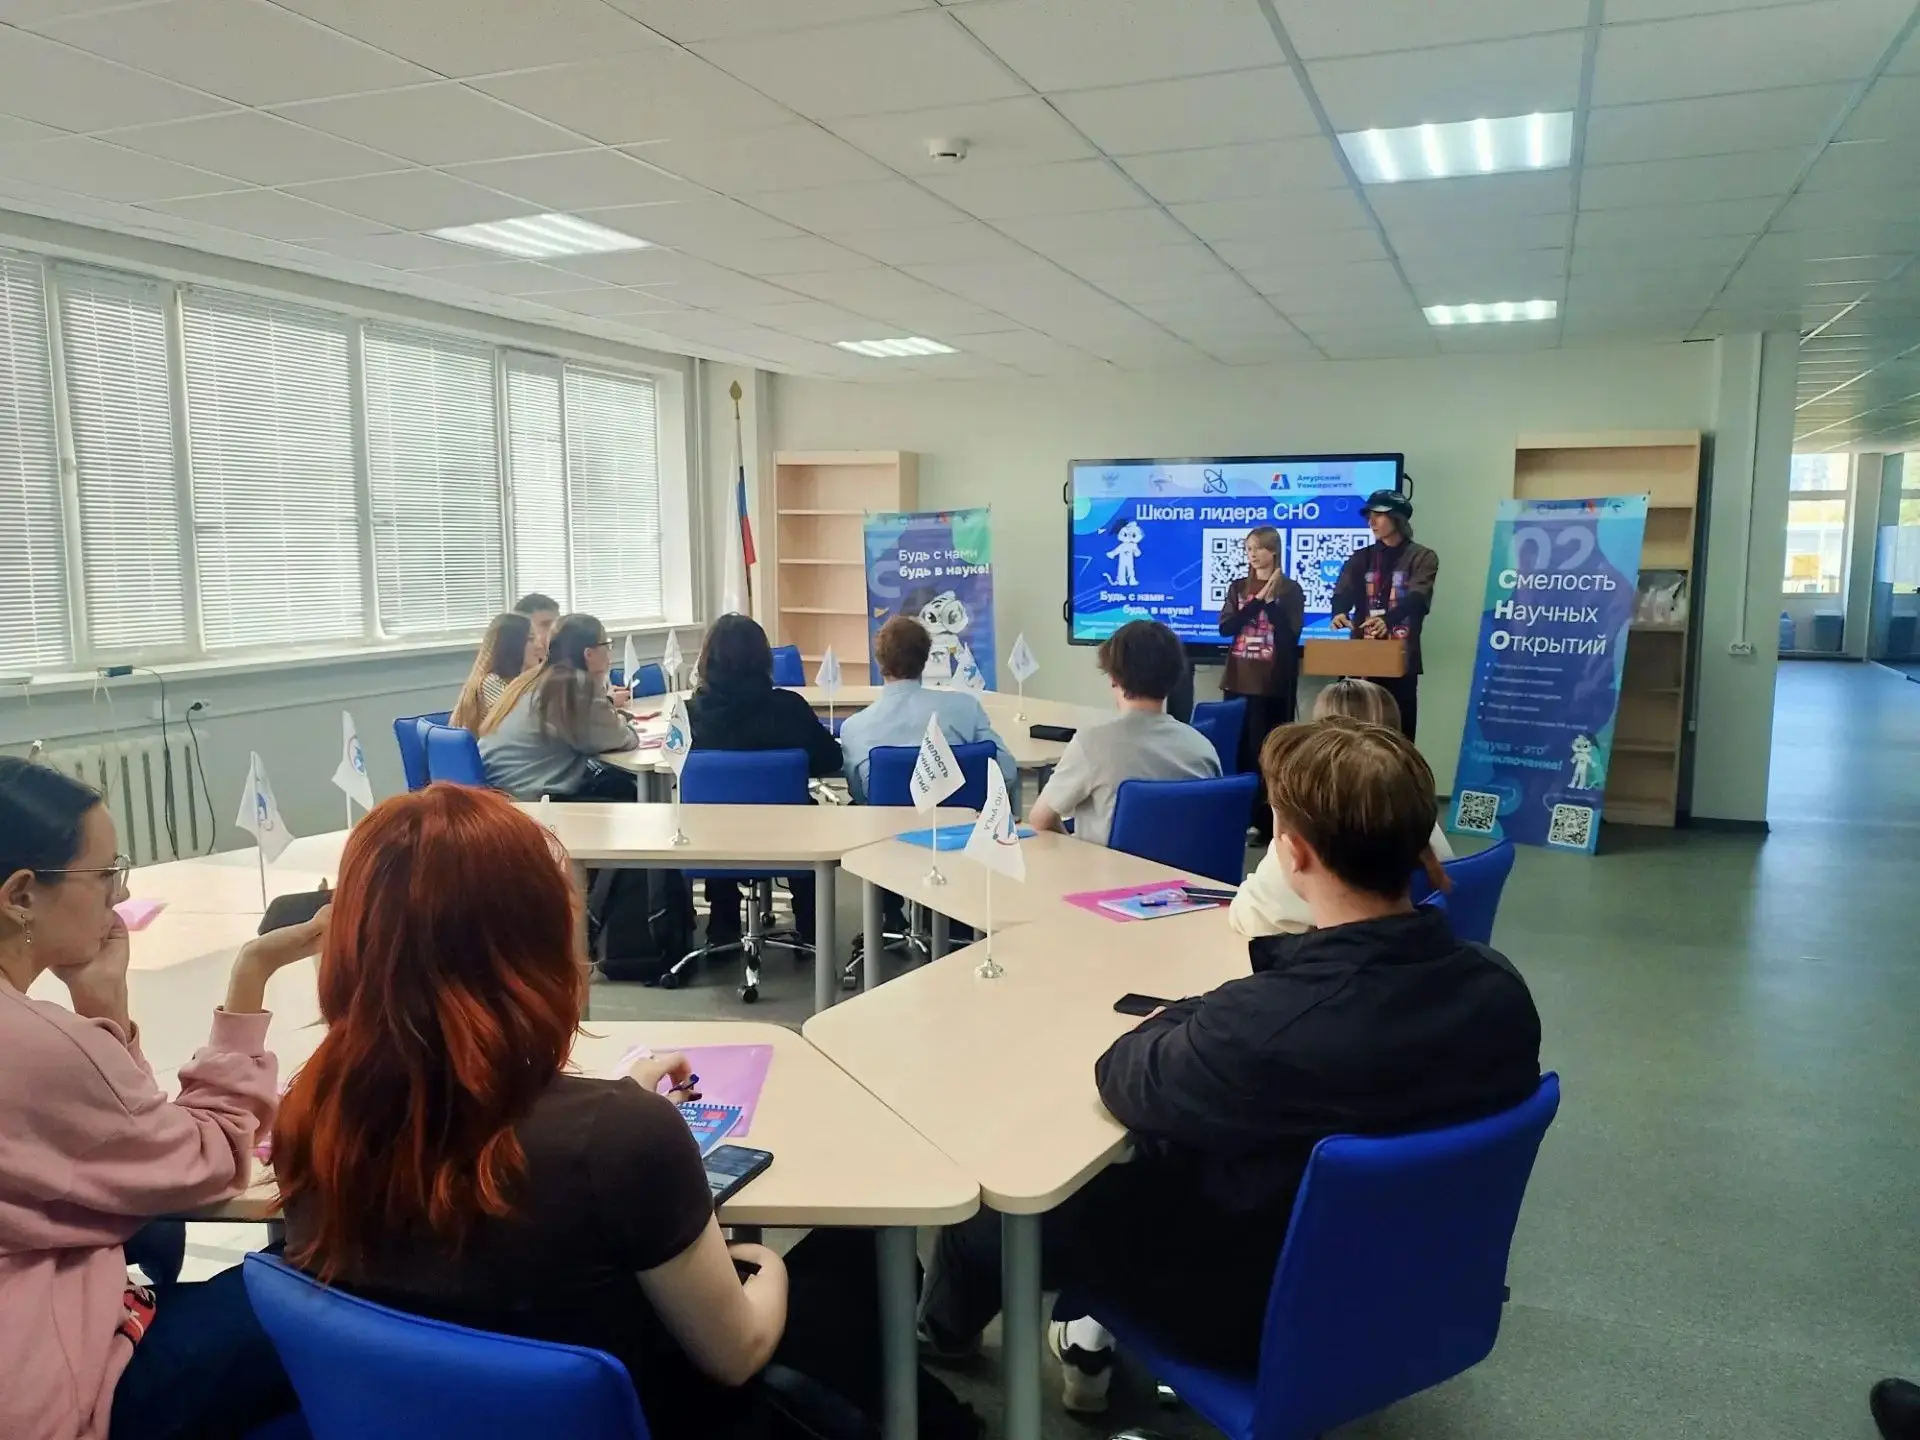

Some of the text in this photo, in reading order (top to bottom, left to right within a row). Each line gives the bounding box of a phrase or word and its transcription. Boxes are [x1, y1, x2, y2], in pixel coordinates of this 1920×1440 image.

[1136, 502, 1320, 524] Школа лидера СНО
[899, 548, 978, 564] Будь с нами
[899, 563, 990, 580] будь в науке!
[1498, 569, 1617, 591] Смелость
[1099, 591, 1126, 603] Будь
[1128, 594, 1136, 602] с
[1137, 594, 1165, 602] нами
[1123, 604, 1194, 617] будь в науке!
[1493, 599, 1599, 626] Научных
[1489, 629, 1607, 660] Открытий
[924, 736, 949, 778] мелость
